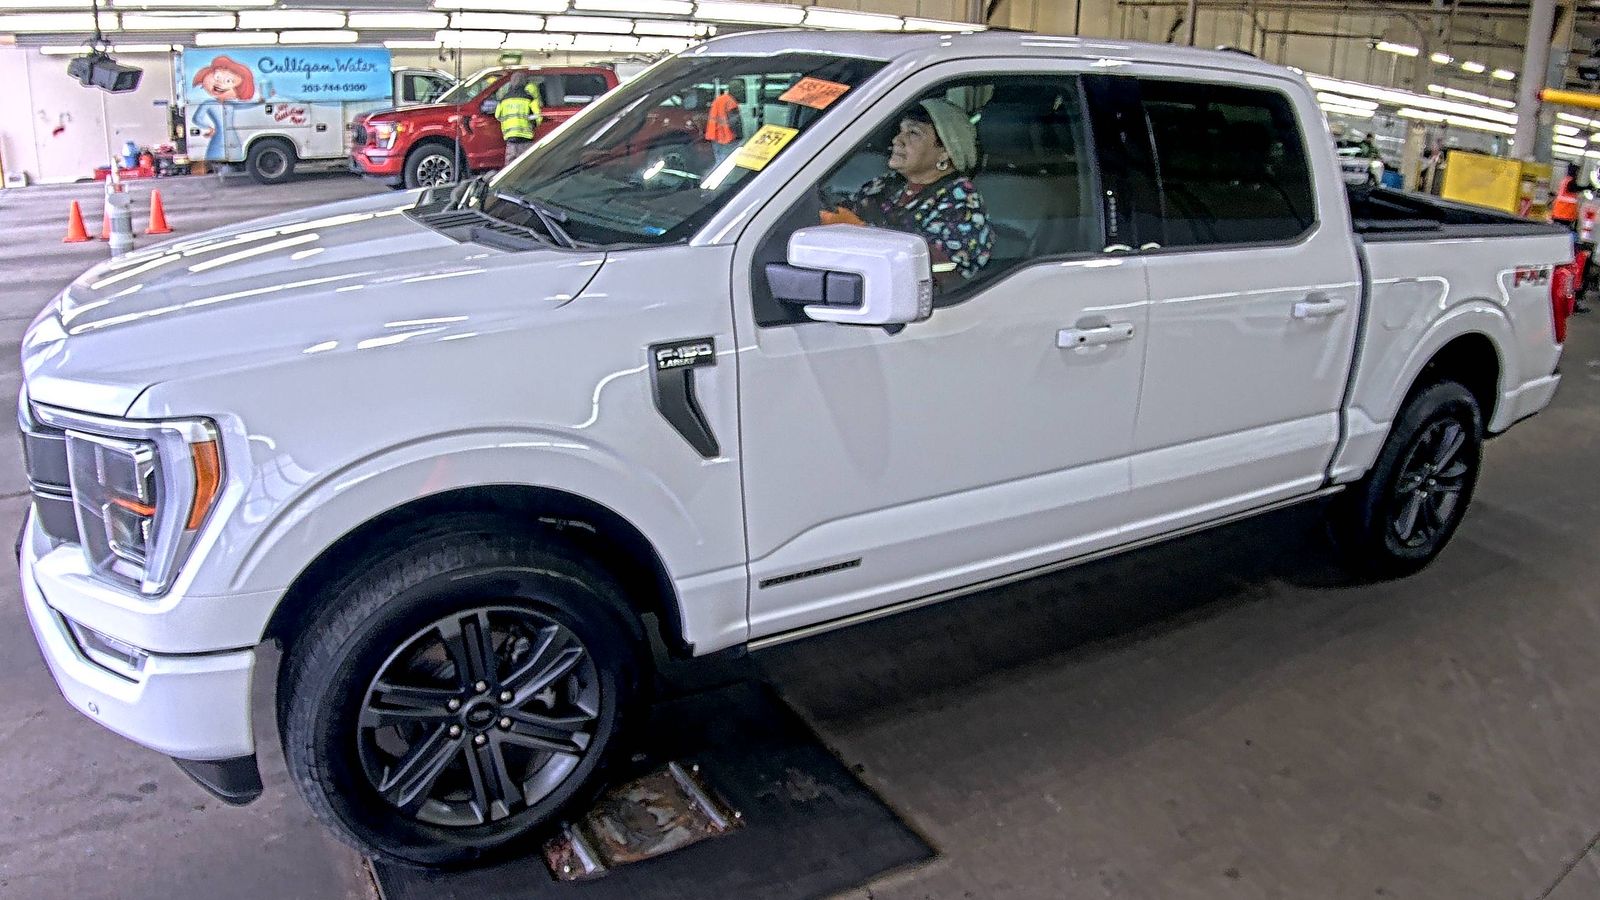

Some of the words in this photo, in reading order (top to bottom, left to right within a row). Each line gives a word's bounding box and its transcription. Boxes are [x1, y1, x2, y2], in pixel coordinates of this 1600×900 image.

[257, 56, 334, 79] Culligan
[334, 57, 378, 73] Water
[656, 343, 713, 361] F-150
